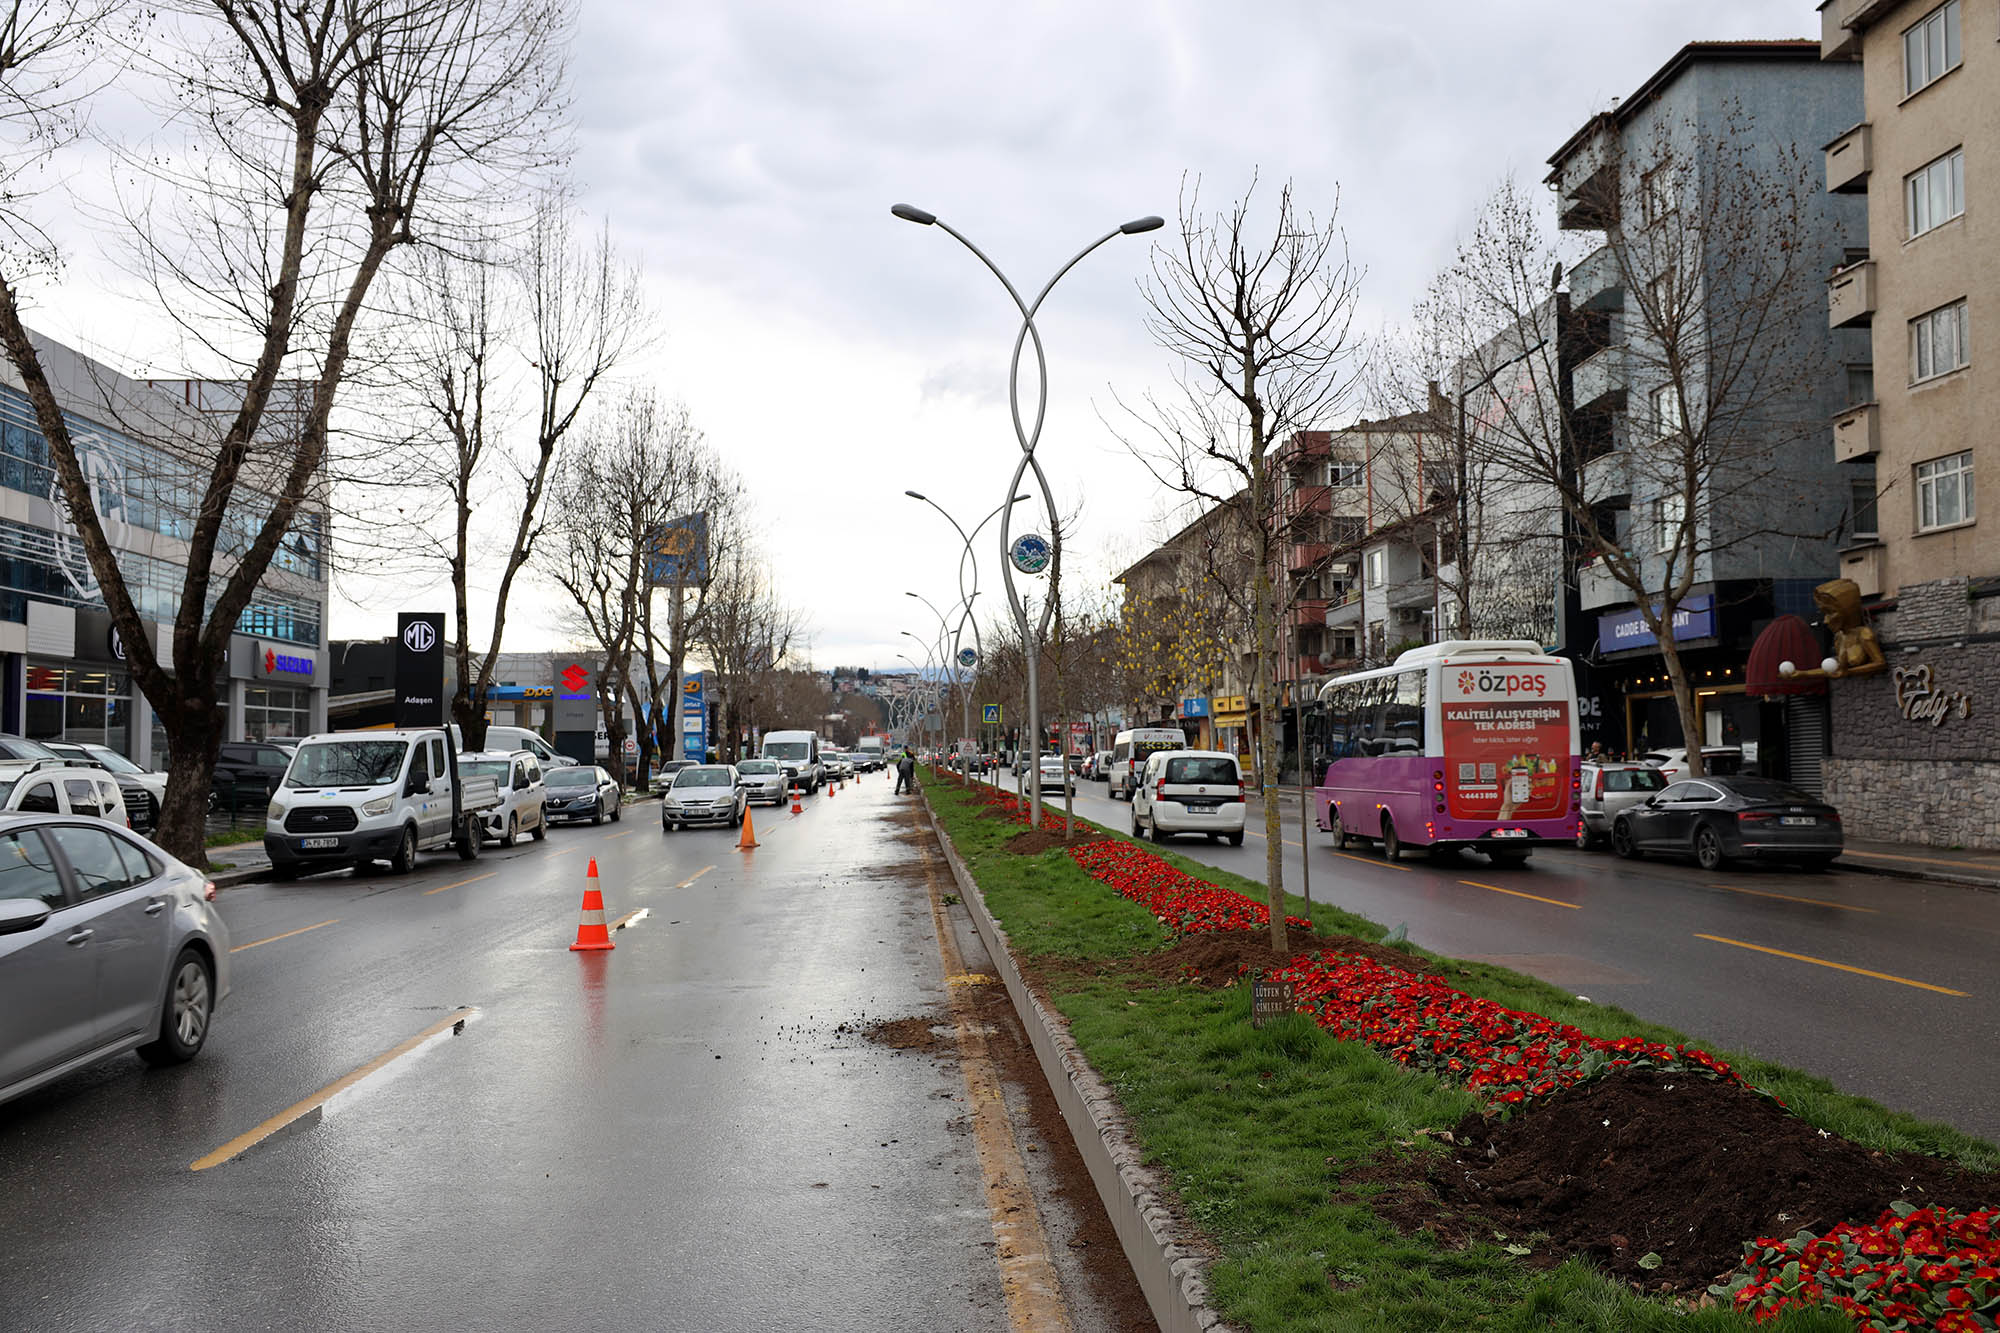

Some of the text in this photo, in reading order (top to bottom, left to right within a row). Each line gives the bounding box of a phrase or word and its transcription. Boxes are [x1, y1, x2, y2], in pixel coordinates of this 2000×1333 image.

[1615, 611, 1689, 638] CADDE REANT
[407, 624, 432, 649] MG
[276, 655, 313, 675] SUZUKI
[523, 687, 553, 698] ope
[1479, 670, 1547, 697] özpaş
[404, 696, 433, 704] Adaşen
[1578, 696, 1602, 716] DE
[1903, 688, 1968, 727] Tedy's
[1447, 706, 1561, 722] KALİTELİ ALIŞVERİŞİN
[1474, 718, 1536, 731] TEK ADRESİ
[1255, 984, 1280, 998] LÜTFEN
